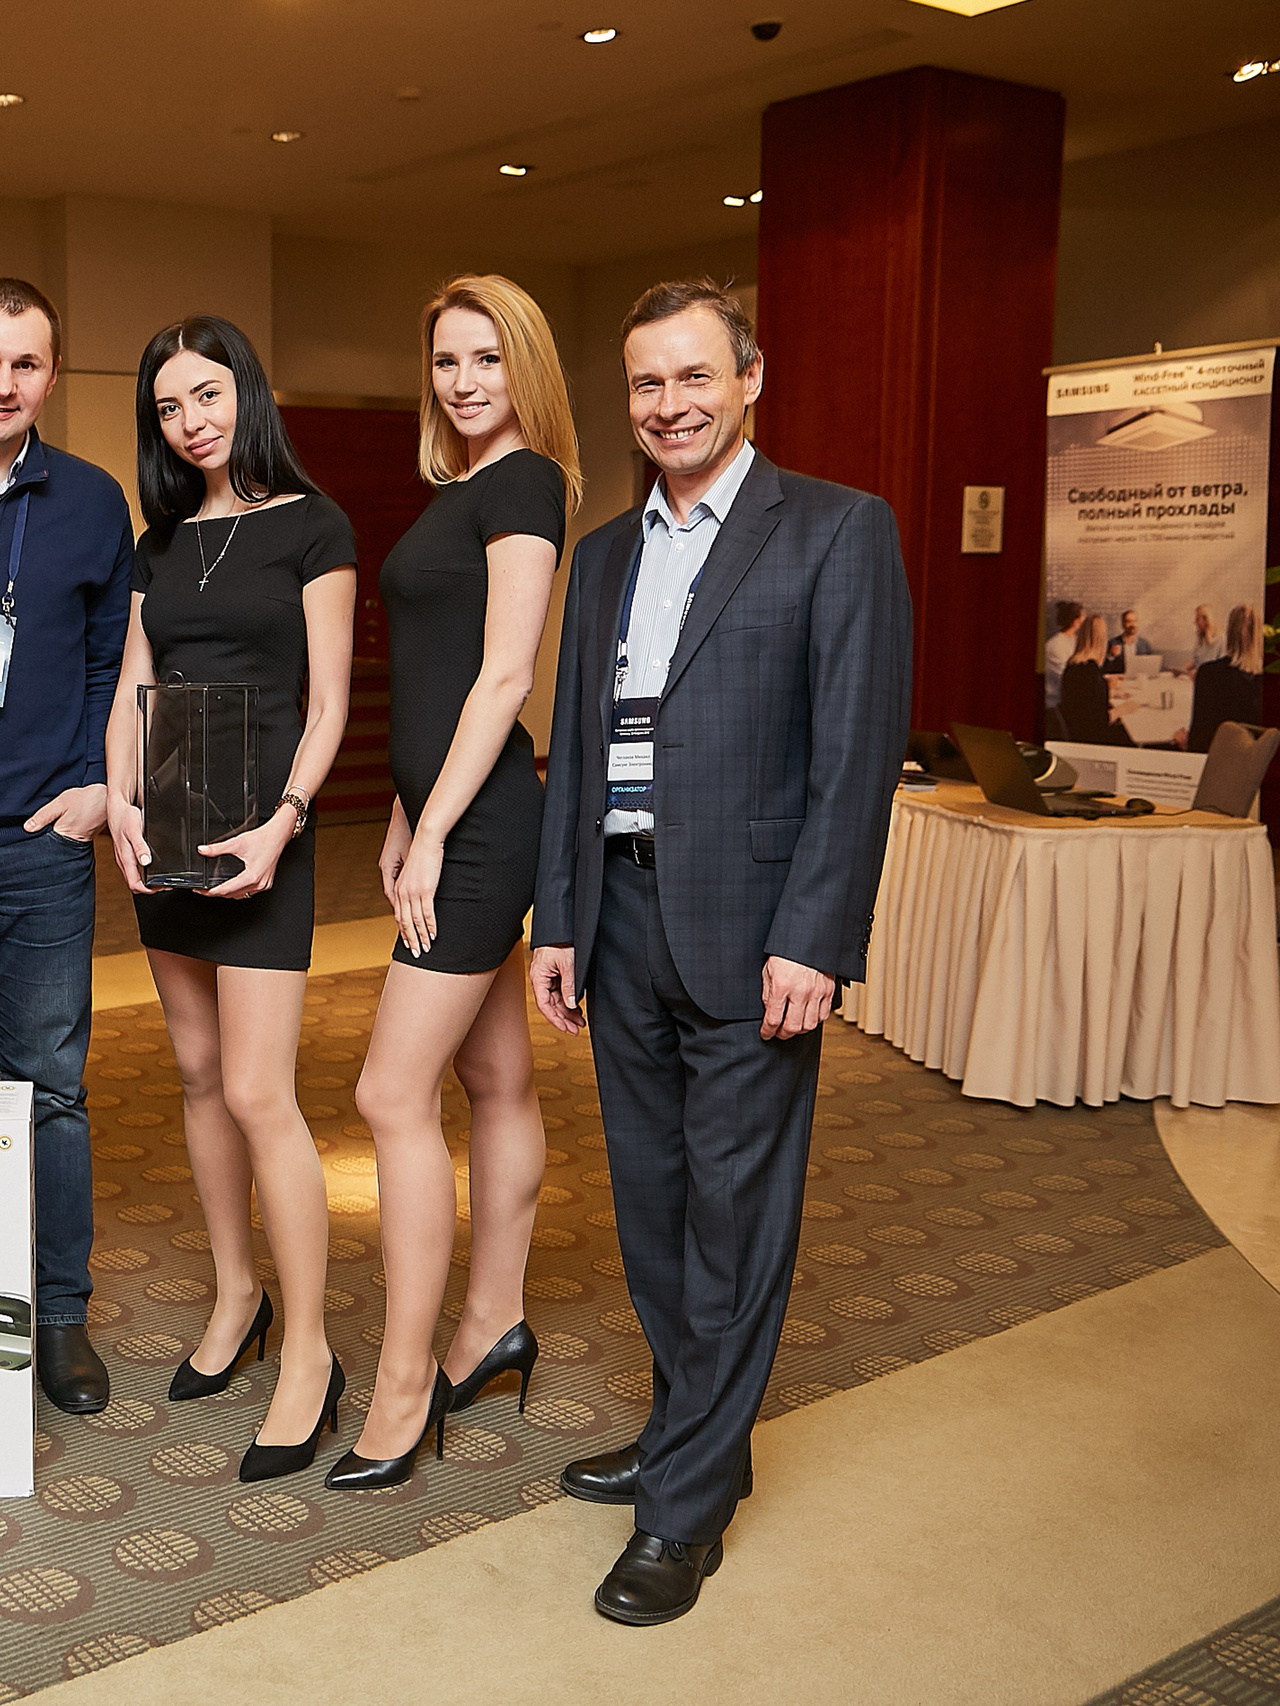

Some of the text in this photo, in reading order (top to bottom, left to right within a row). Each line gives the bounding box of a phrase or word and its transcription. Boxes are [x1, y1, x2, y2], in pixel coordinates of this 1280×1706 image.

[1067, 483, 1248, 503] Свободный от ветра,
[1078, 502, 1235, 520] полный прохлады
[620, 717, 651, 726] SAMSUNG
